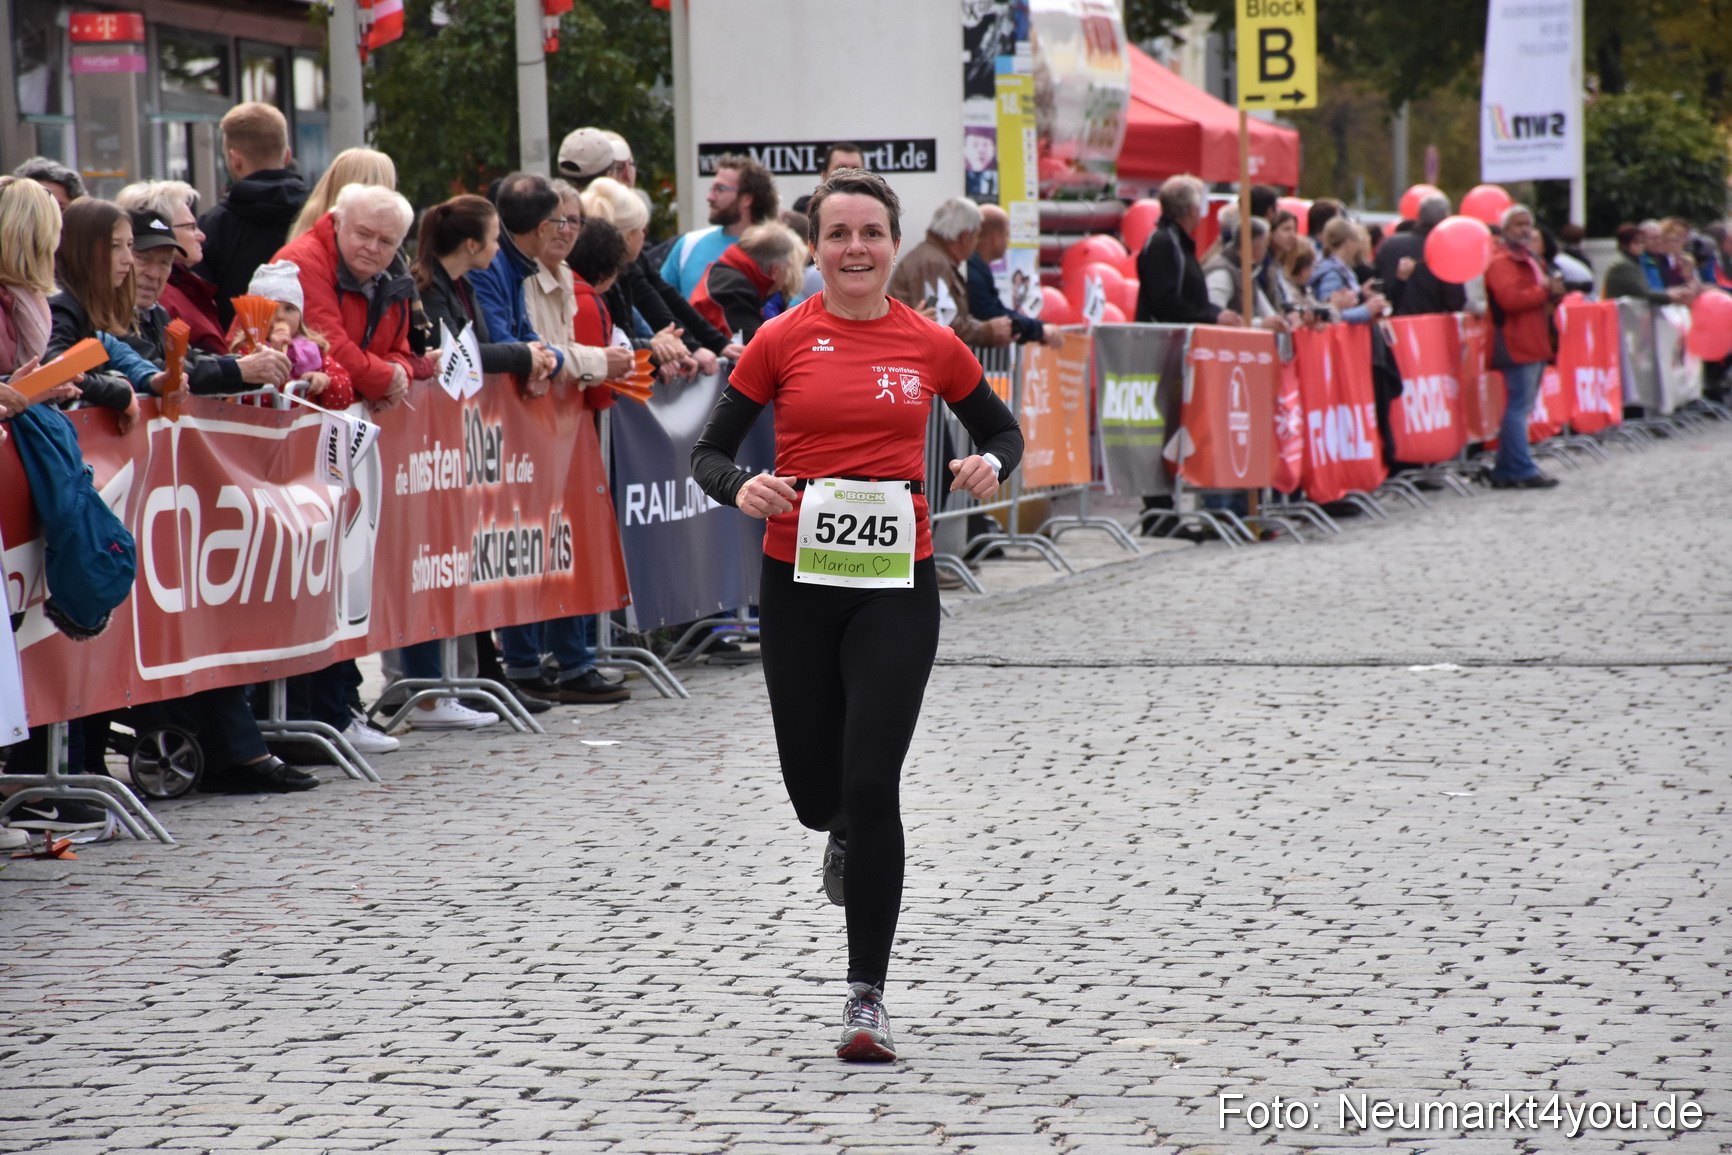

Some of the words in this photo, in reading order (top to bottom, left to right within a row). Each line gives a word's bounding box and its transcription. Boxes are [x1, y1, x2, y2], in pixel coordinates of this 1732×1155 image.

[1246, 0, 1305, 17] Block
[96, 13, 117, 40] T
[1258, 28, 1296, 82] B
[871, 365, 887, 373] TSV
[887, 366, 920, 376] Wolfstein
[1103, 377, 1161, 421] BOCK
[327, 424, 339, 464] swn
[516, 452, 534, 484] die
[846, 491, 886, 502] BOCK
[815, 512, 898, 547] 5245
[812, 551, 865, 573] Marion
